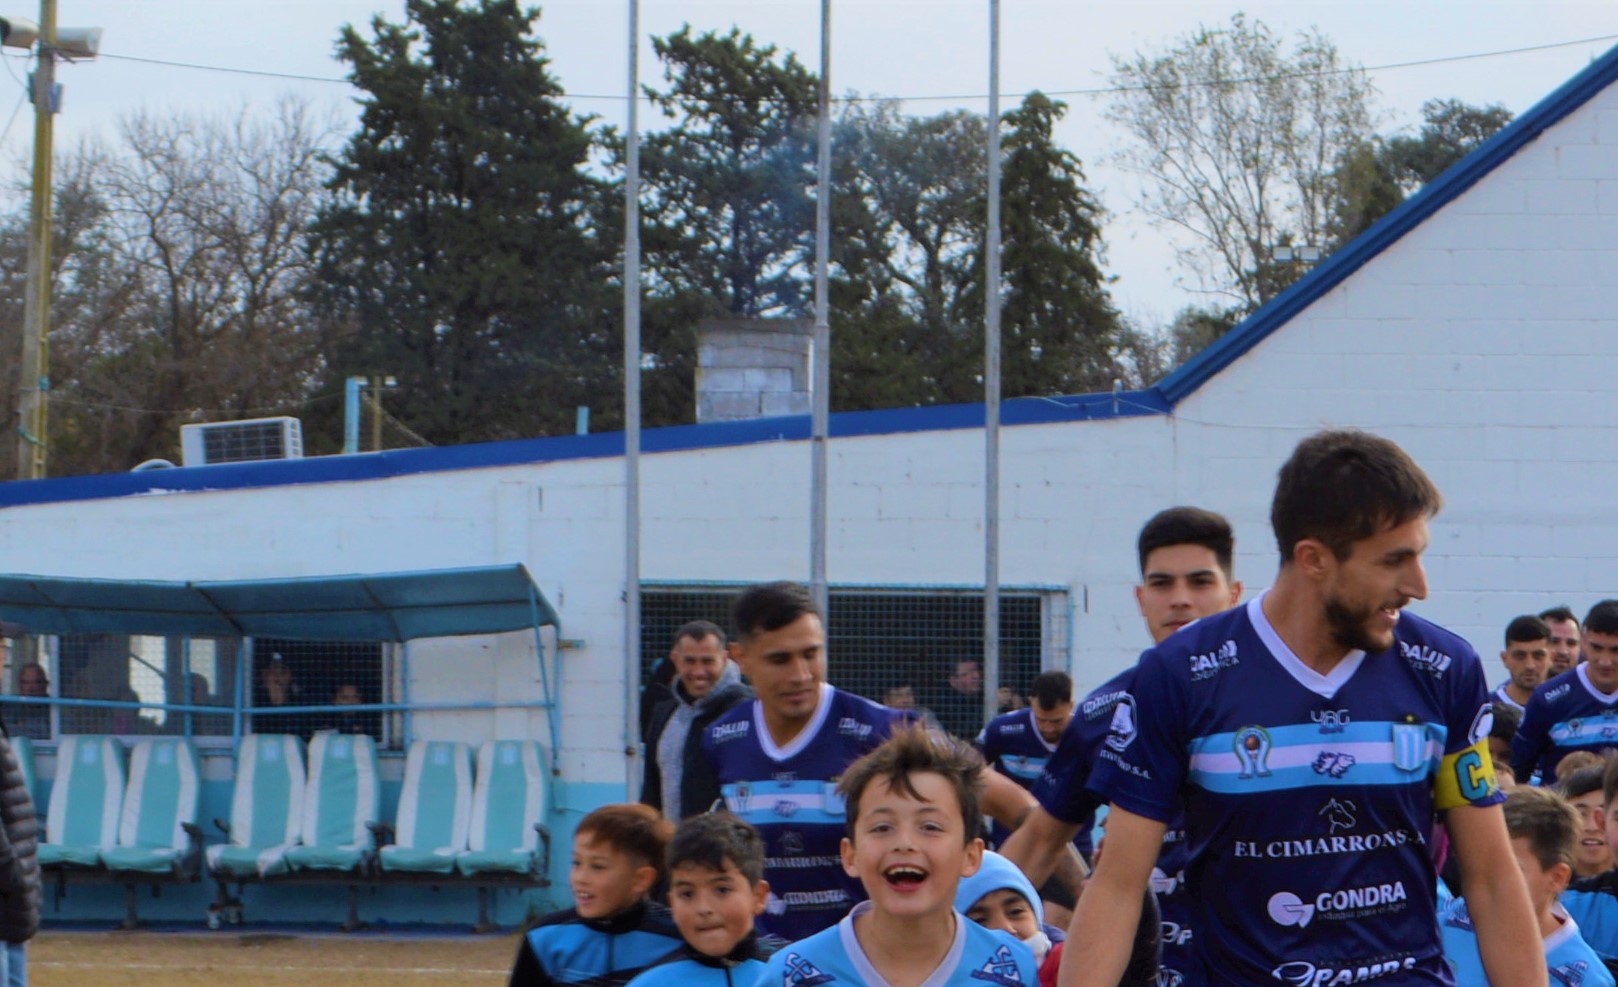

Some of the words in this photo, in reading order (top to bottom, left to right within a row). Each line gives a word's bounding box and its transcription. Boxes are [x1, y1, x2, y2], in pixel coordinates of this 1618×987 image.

[1456, 750, 1489, 800] C
[1234, 841, 1263, 858] EL
[1316, 881, 1407, 911] GONDRA
